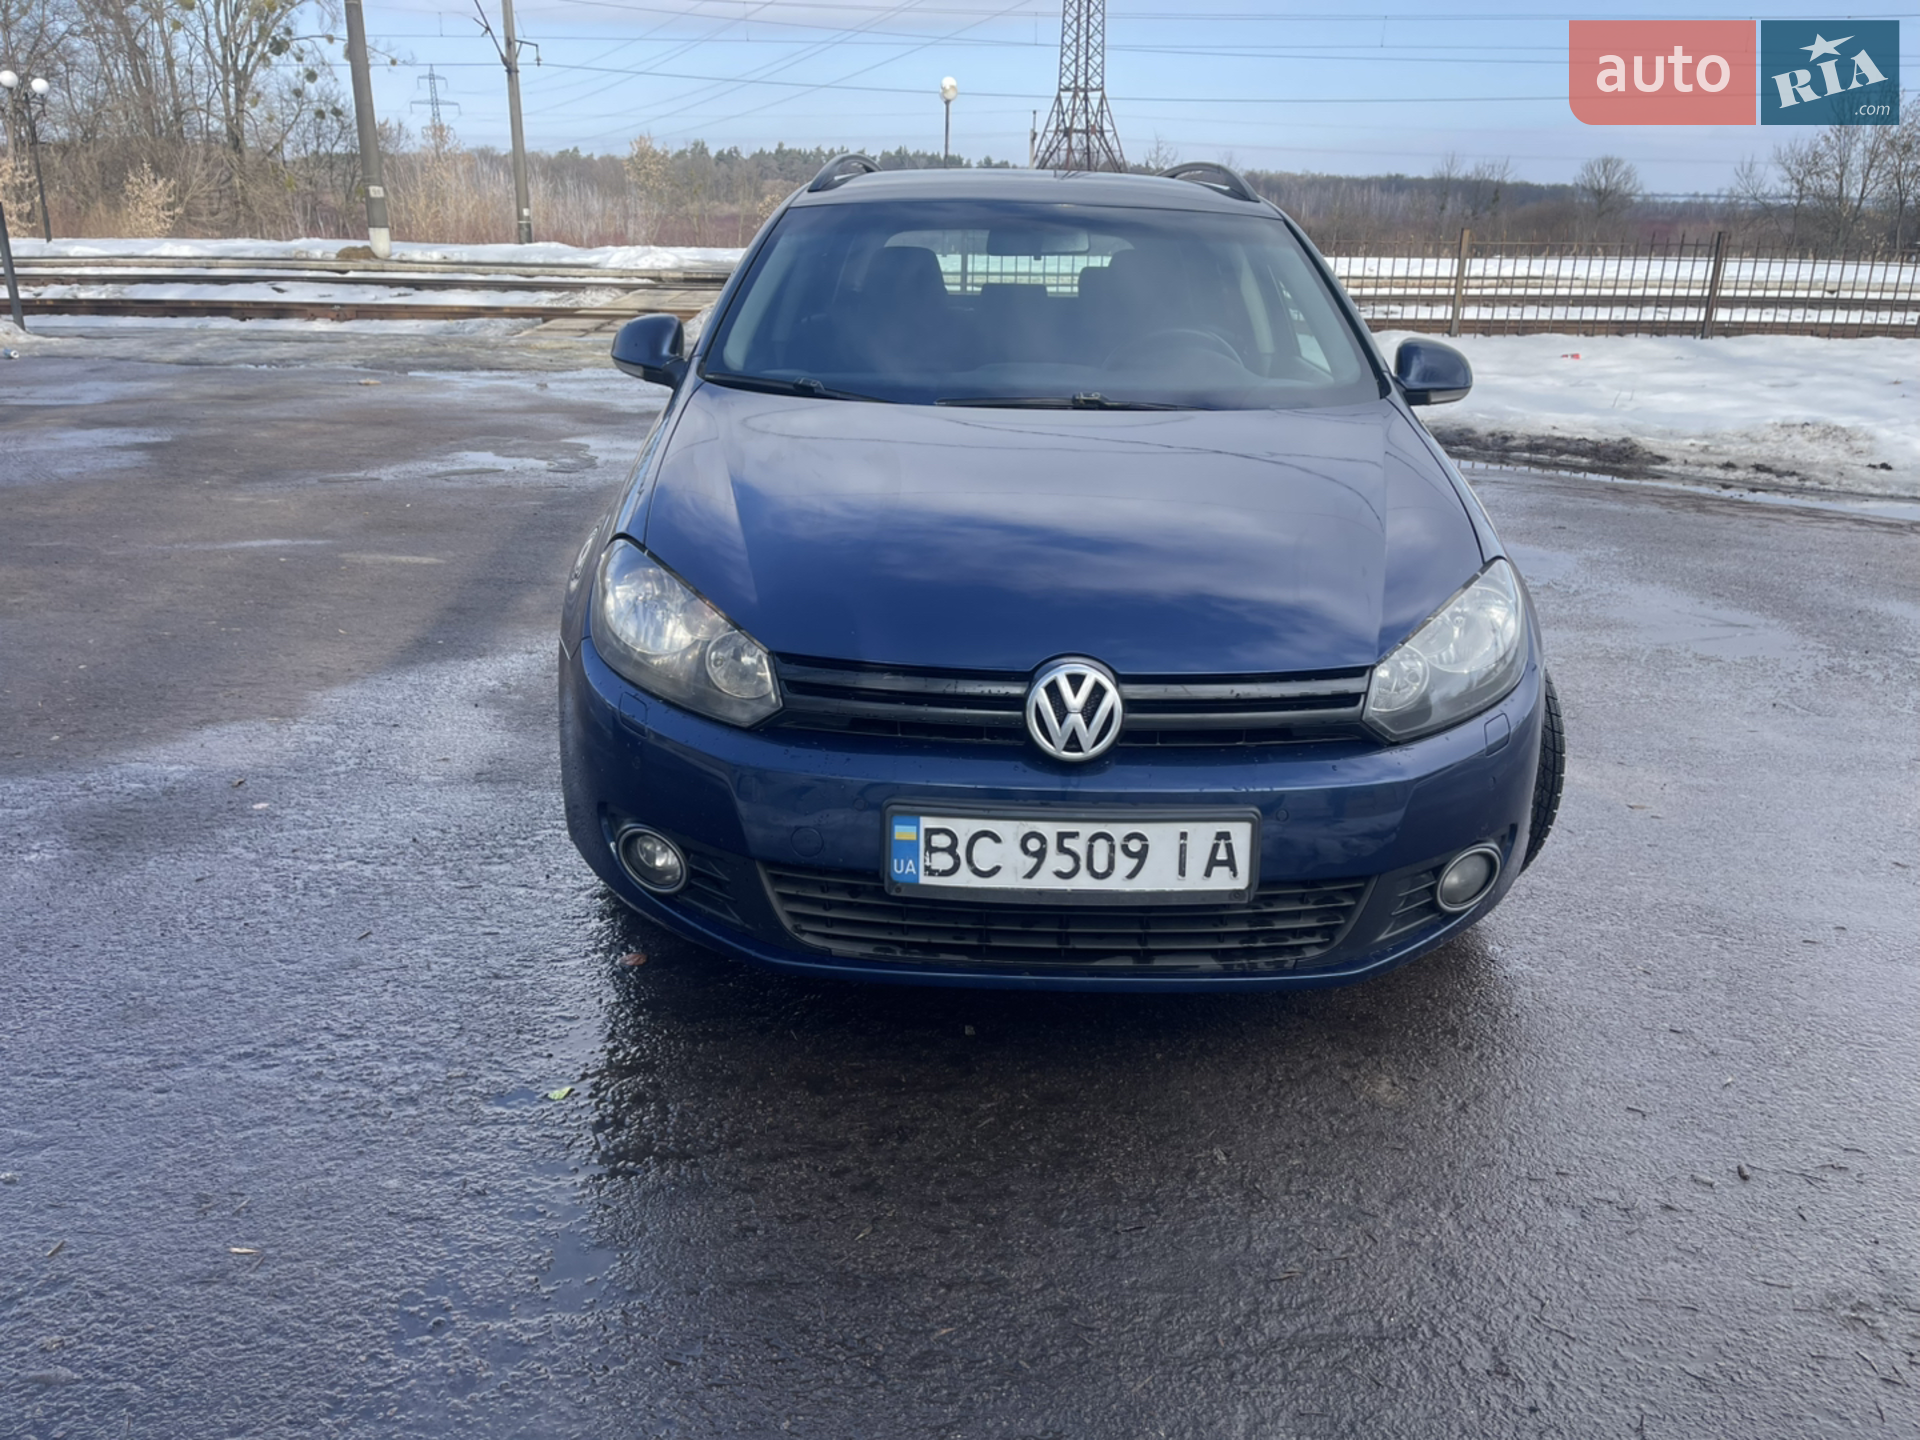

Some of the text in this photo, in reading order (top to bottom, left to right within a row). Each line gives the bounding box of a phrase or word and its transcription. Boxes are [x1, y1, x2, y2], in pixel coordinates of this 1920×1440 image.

[893, 858, 918, 875] UA
[923, 827, 1003, 878] BC
[1019, 829, 1150, 880] 9509
